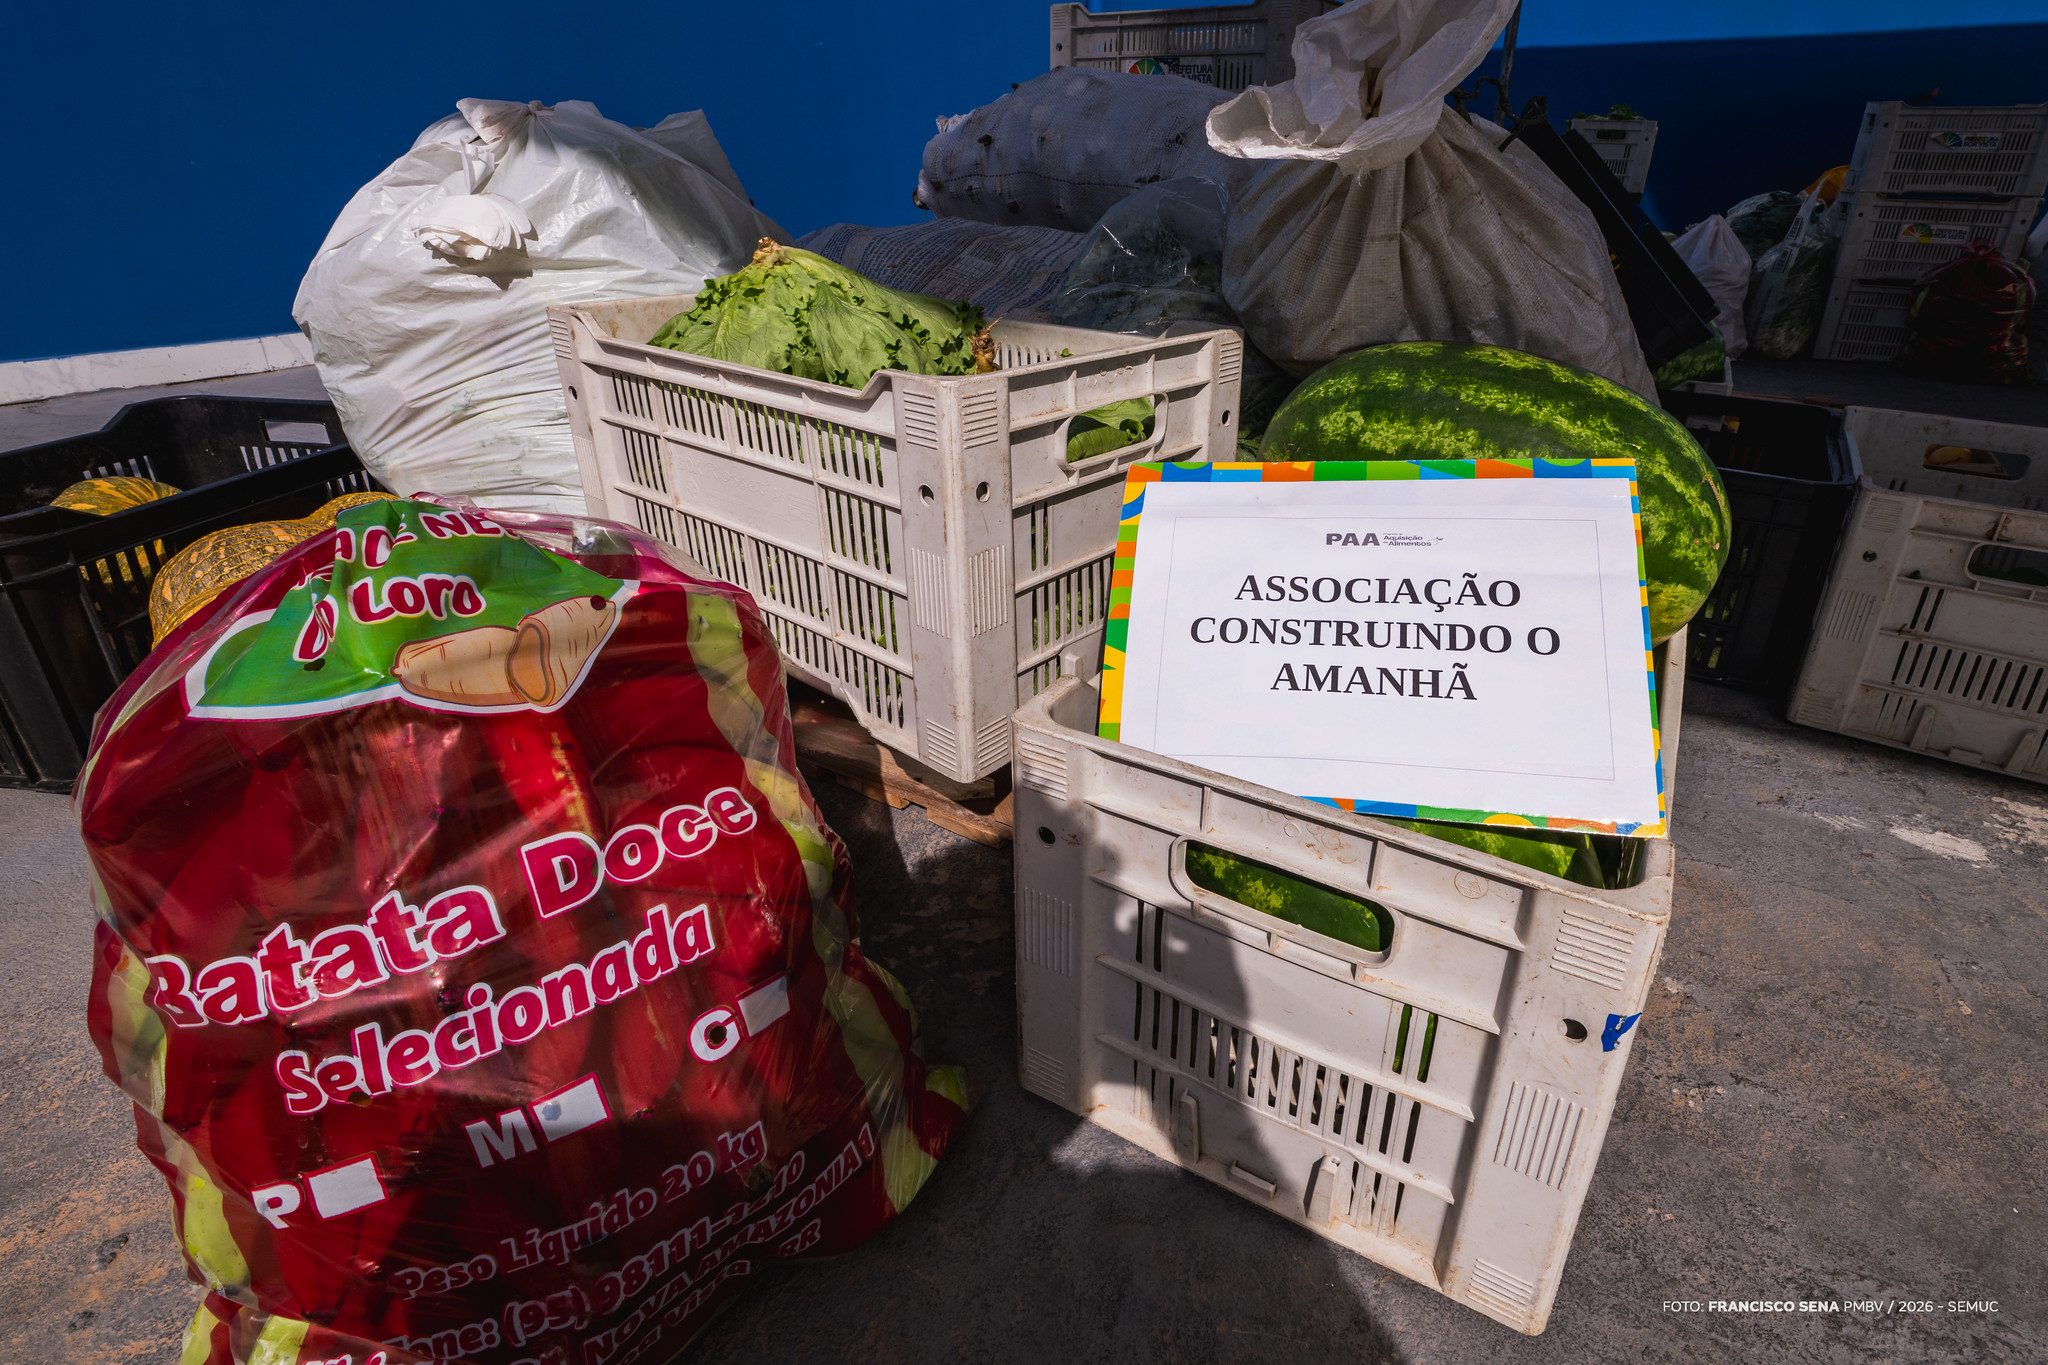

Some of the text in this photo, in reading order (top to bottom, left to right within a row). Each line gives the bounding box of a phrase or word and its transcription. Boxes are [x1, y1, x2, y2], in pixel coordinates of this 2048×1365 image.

[1168, 64, 1212, 74] PREFEITURA
[418, 511, 521, 540] NE
[1326, 532, 1380, 546] PAA
[1235, 572, 1521, 612] ASSOCIAÇÃO
[1190, 616, 1561, 656] CONSTRUINDO O
[1270, 661, 1478, 701] AMANHÃ
[147, 785, 758, 1028] Batata Doce
[275, 902, 716, 1116] Selecionada
[463, 1107, 538, 1169] M
[250, 1181, 304, 1230] P
[391, 1120, 768, 1301] Peso Líquido 20 kg
[583, 1271, 695, 1365] NOVA
[693, 1140, 863, 1280] AMAZONIA
[502, 1284, 590, 1348] (95)
